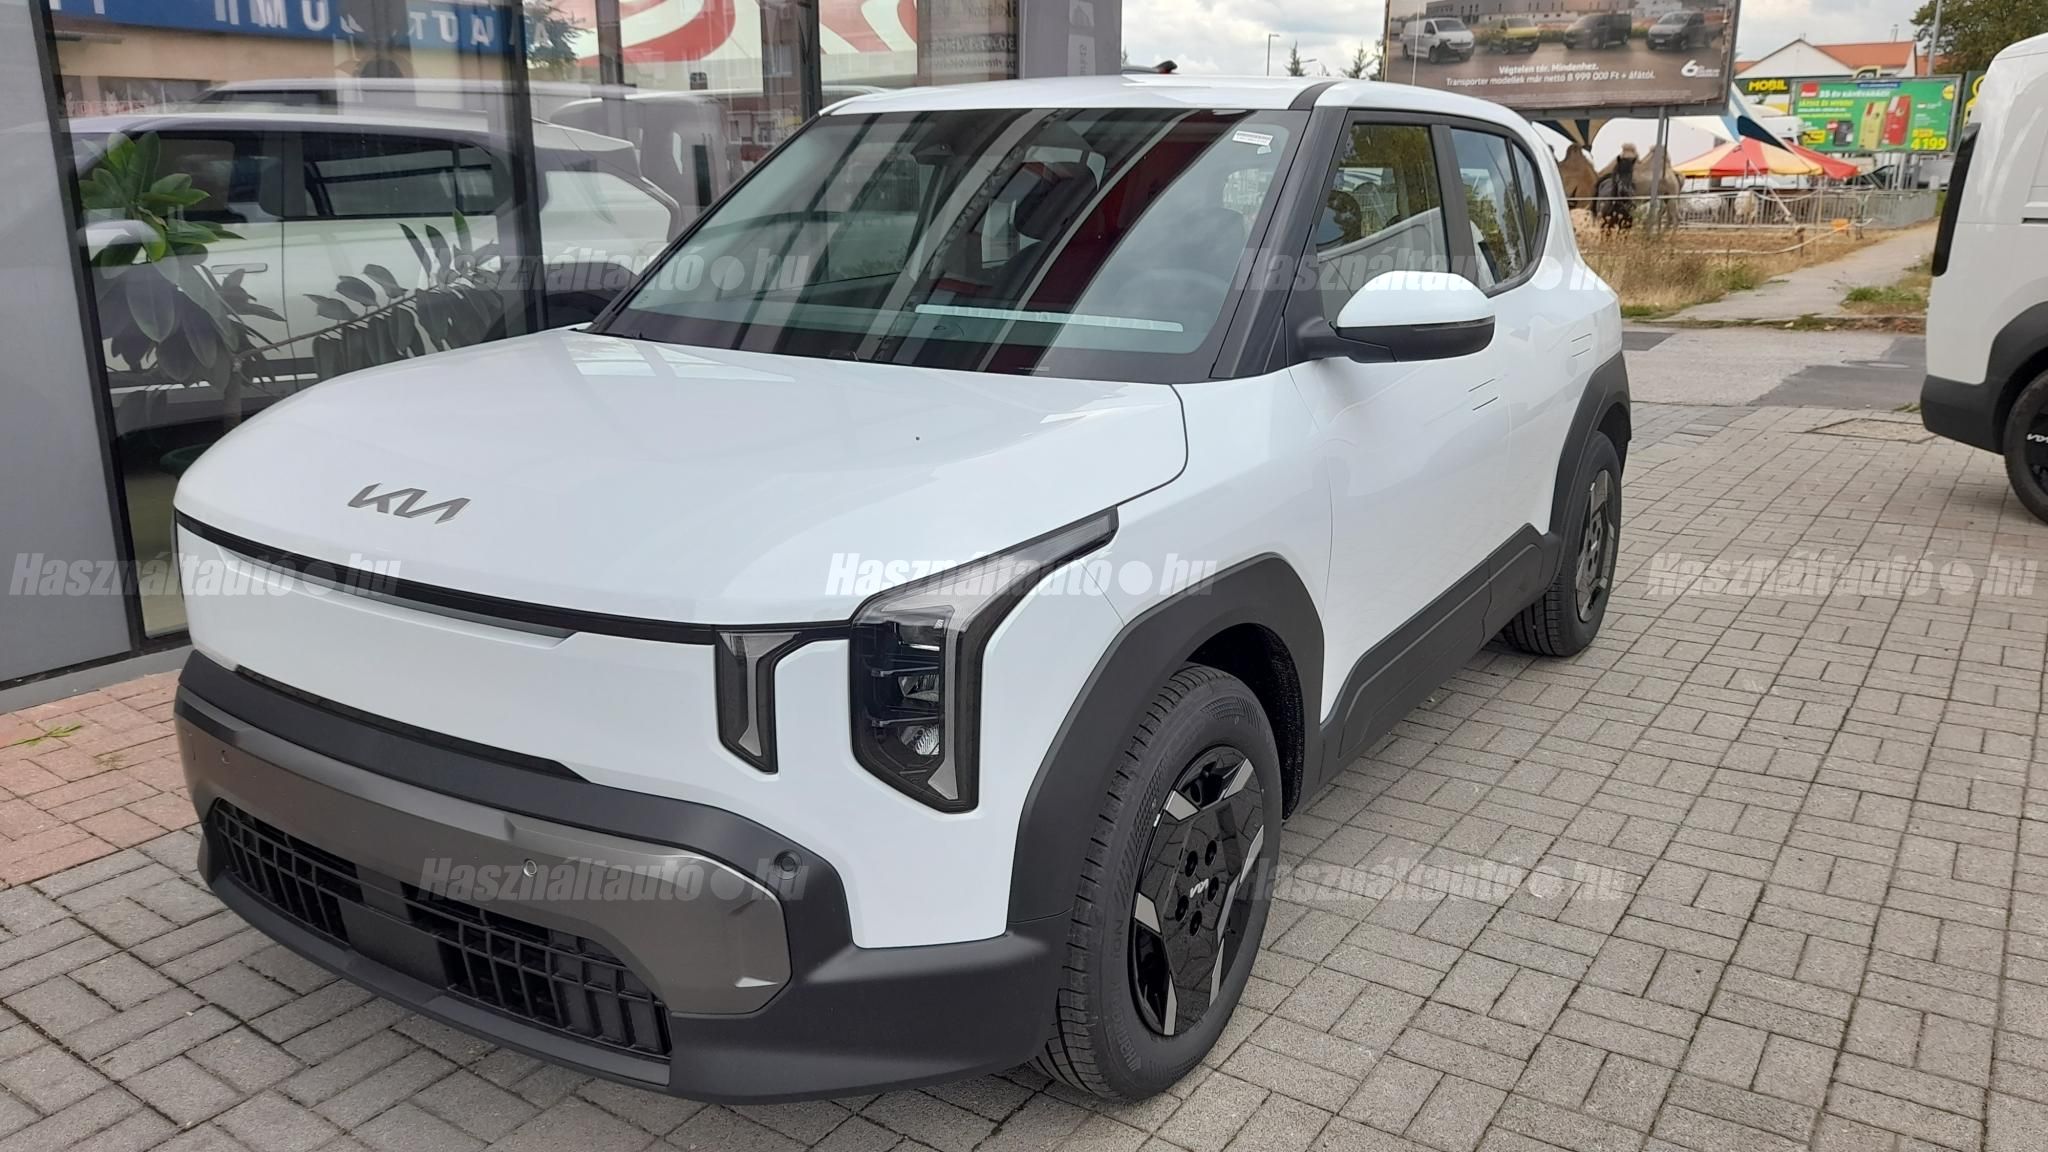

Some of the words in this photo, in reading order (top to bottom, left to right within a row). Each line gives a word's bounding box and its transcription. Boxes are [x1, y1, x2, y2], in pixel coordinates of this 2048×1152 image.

[1499, 64, 1535, 75] Végtelen
[1536, 63, 1549, 73] tér.
[1551, 62, 1600, 72] Mindenhez.
[1446, 77, 1488, 87] Transporter
[1489, 75, 1525, 85] modellek
[1526, 73, 1542, 83] már
[1574, 71, 1591, 81] 999
[1592, 71, 1609, 80] 000
[1610, 70, 1620, 79] Ft
[347, 482, 472, 525] KIA
